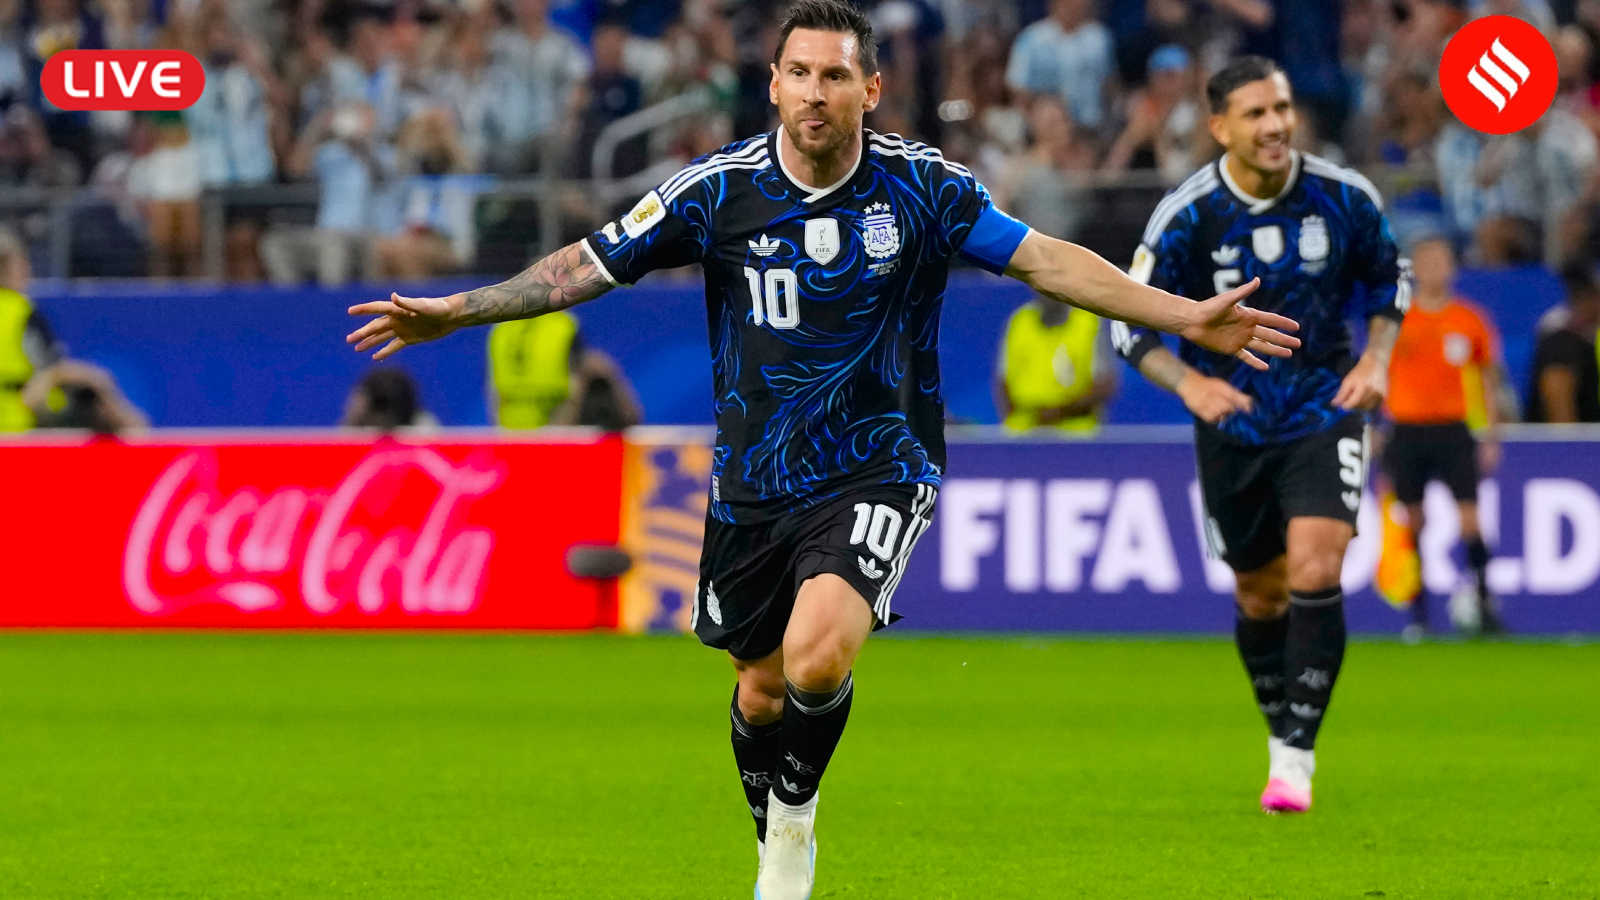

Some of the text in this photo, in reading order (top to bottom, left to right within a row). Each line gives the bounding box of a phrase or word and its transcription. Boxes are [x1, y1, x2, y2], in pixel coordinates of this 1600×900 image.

[743, 266, 800, 330] 10
[1337, 437, 1362, 488] 5
[850, 502, 903, 562] 10
[941, 479, 1182, 593] FIFA
